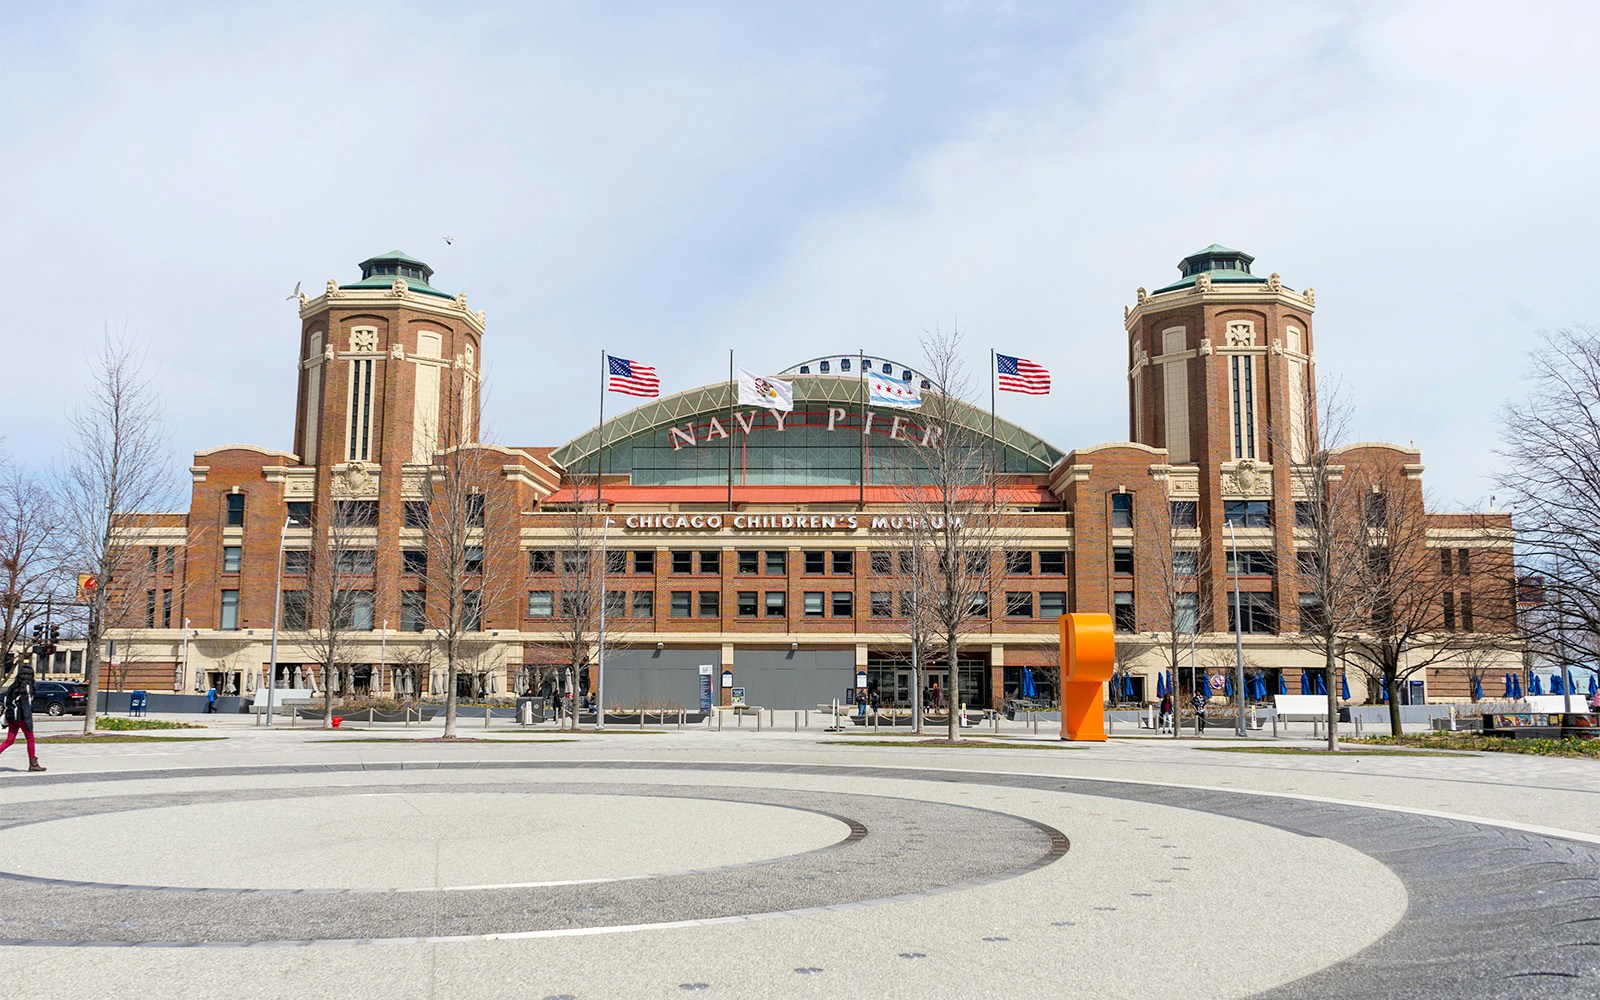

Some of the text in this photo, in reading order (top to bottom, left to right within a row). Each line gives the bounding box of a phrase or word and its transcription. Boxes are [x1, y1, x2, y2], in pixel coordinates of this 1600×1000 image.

[668, 407, 944, 451] NAVY PIER
[626, 514, 722, 529] CHICAGO
[733, 514, 858, 529] CHILDREN'S
